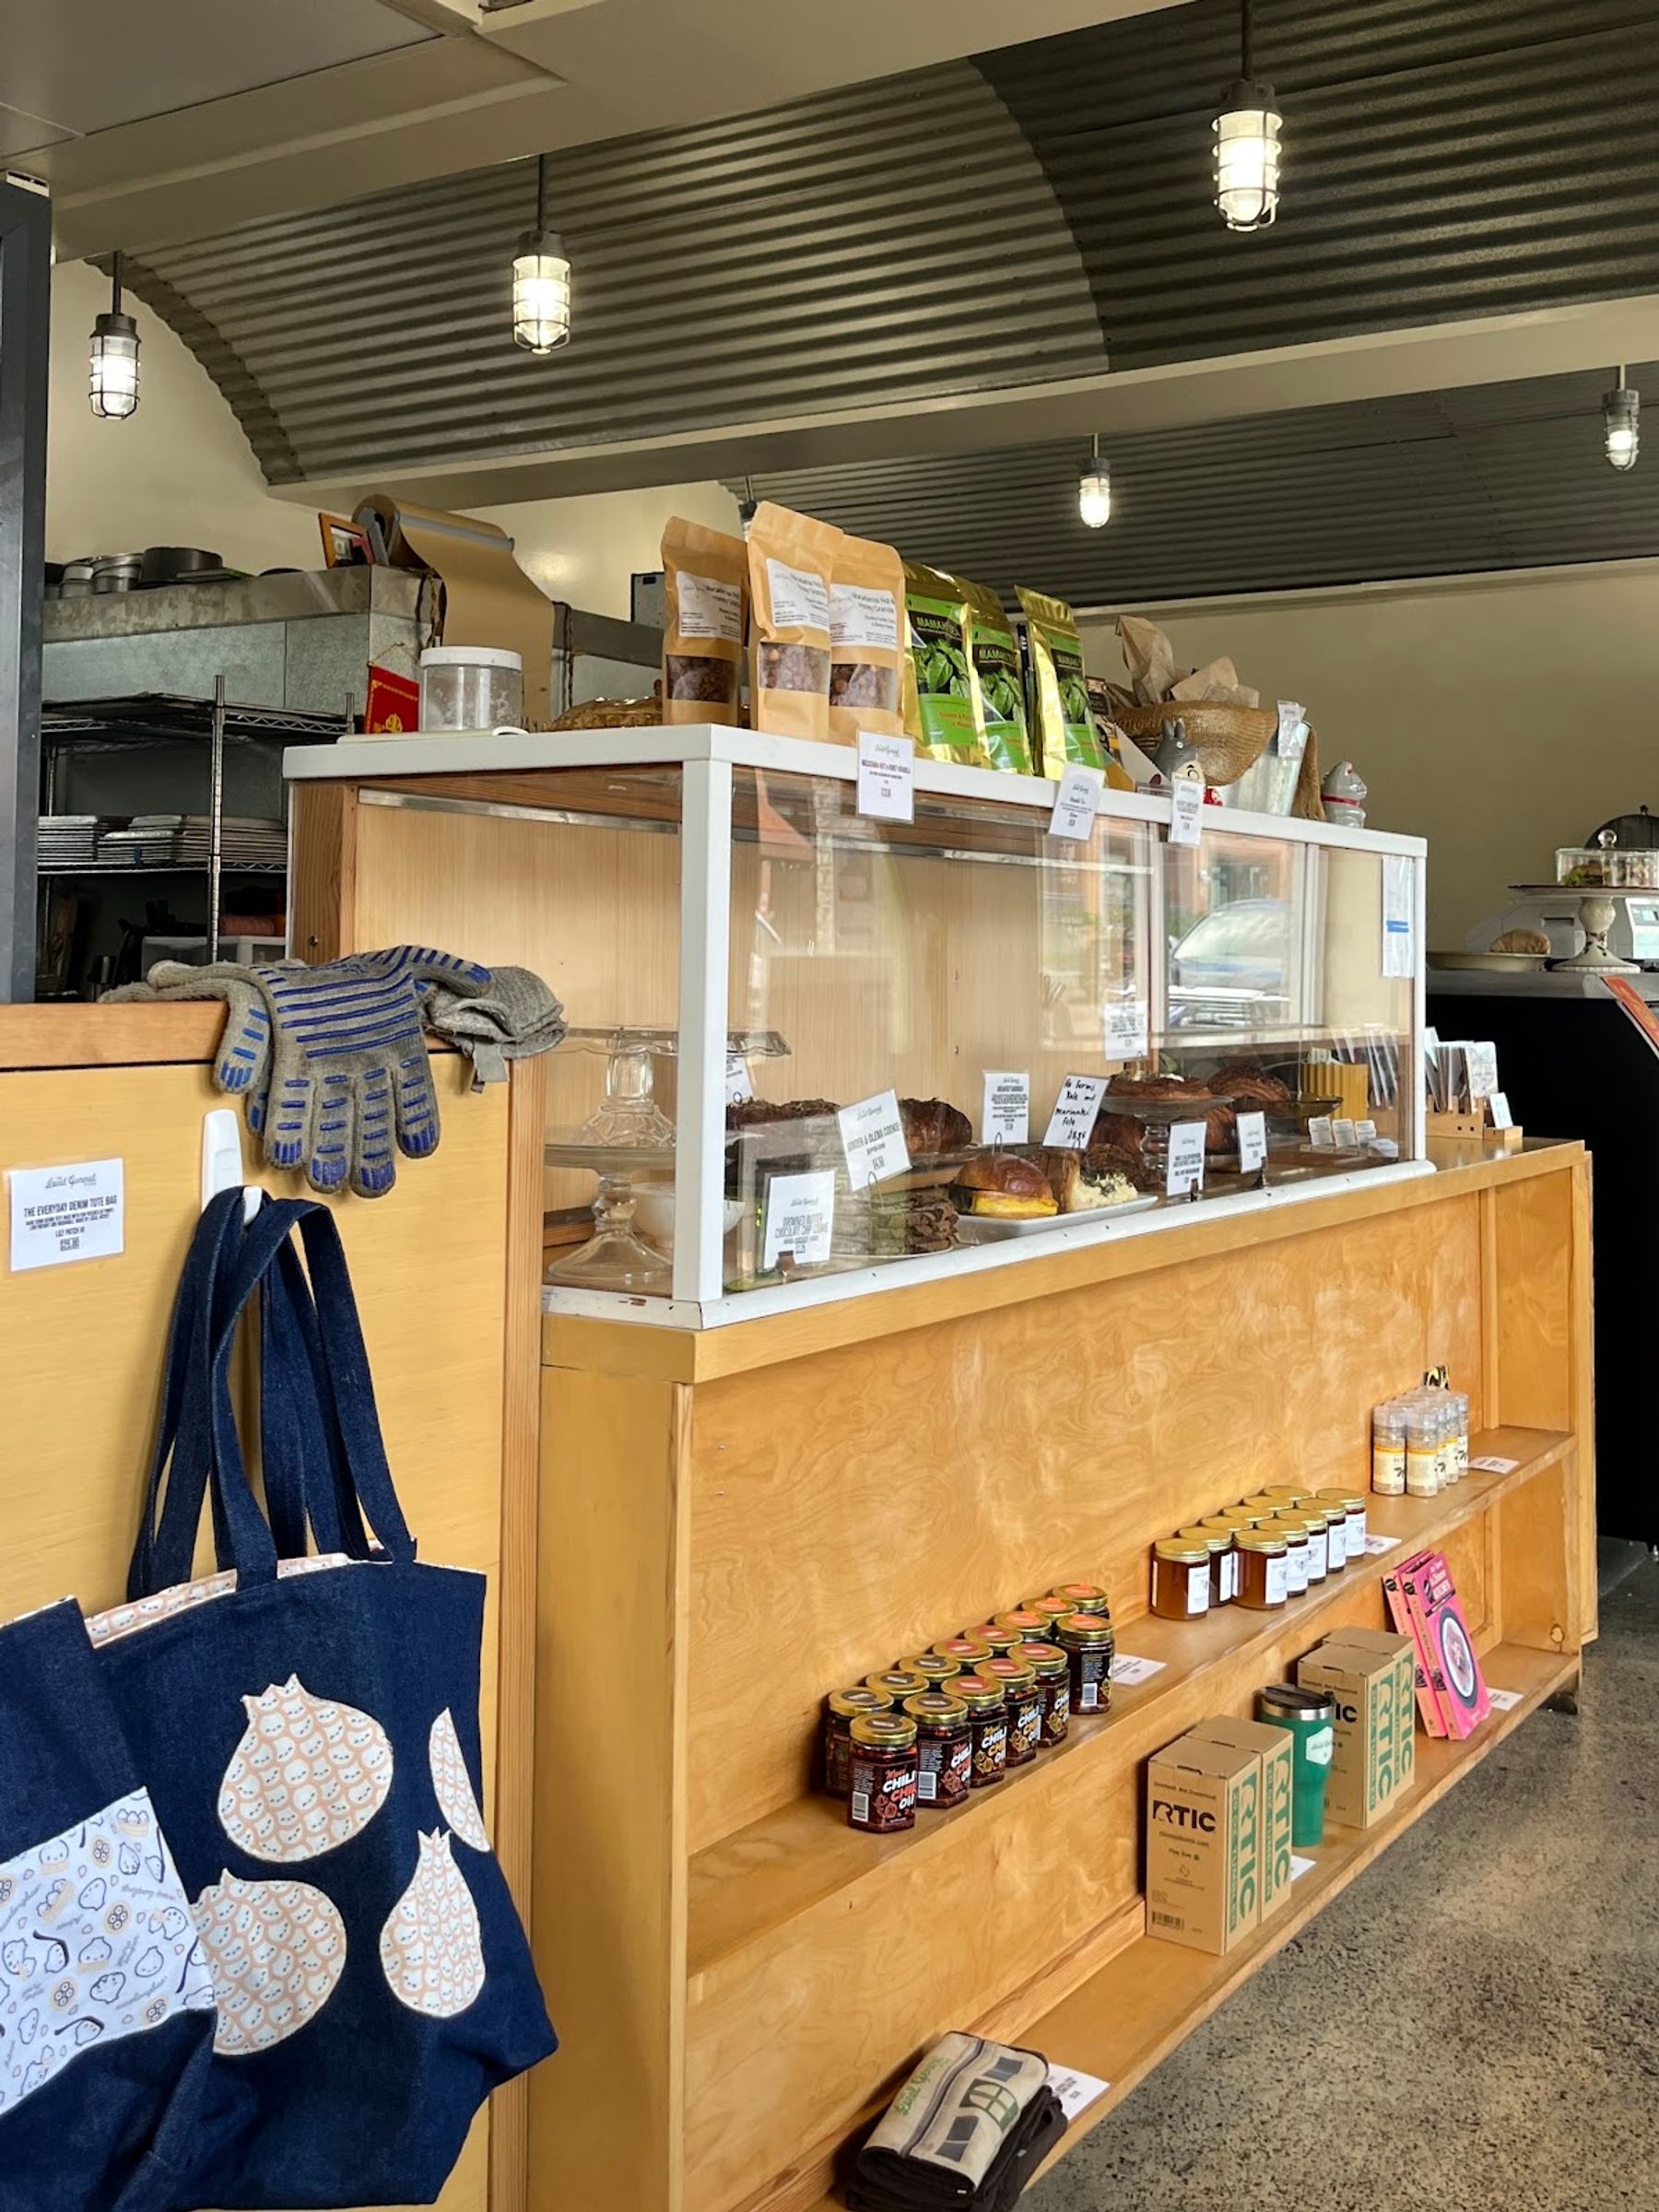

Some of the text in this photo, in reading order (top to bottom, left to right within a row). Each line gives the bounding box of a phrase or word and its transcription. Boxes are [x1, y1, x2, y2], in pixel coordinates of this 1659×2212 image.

[44, 1173, 97, 1189] Local General
[24, 1194, 117, 1218] THE EVERYDAY DENIM TOTE BAG
[1335, 1703, 1358, 1724] IC
[1401, 1652, 1413, 1775] RTIC
[981, 1725, 1007, 1748] CHILI
[1378, 1673, 1394, 1800] RTIC
[882, 1770, 915, 1794] CHILI
[1152, 1799, 1217, 1832] RTIC
[1275, 1748, 1290, 1889] RTIC
[1239, 1771, 1257, 1919] RTIC
